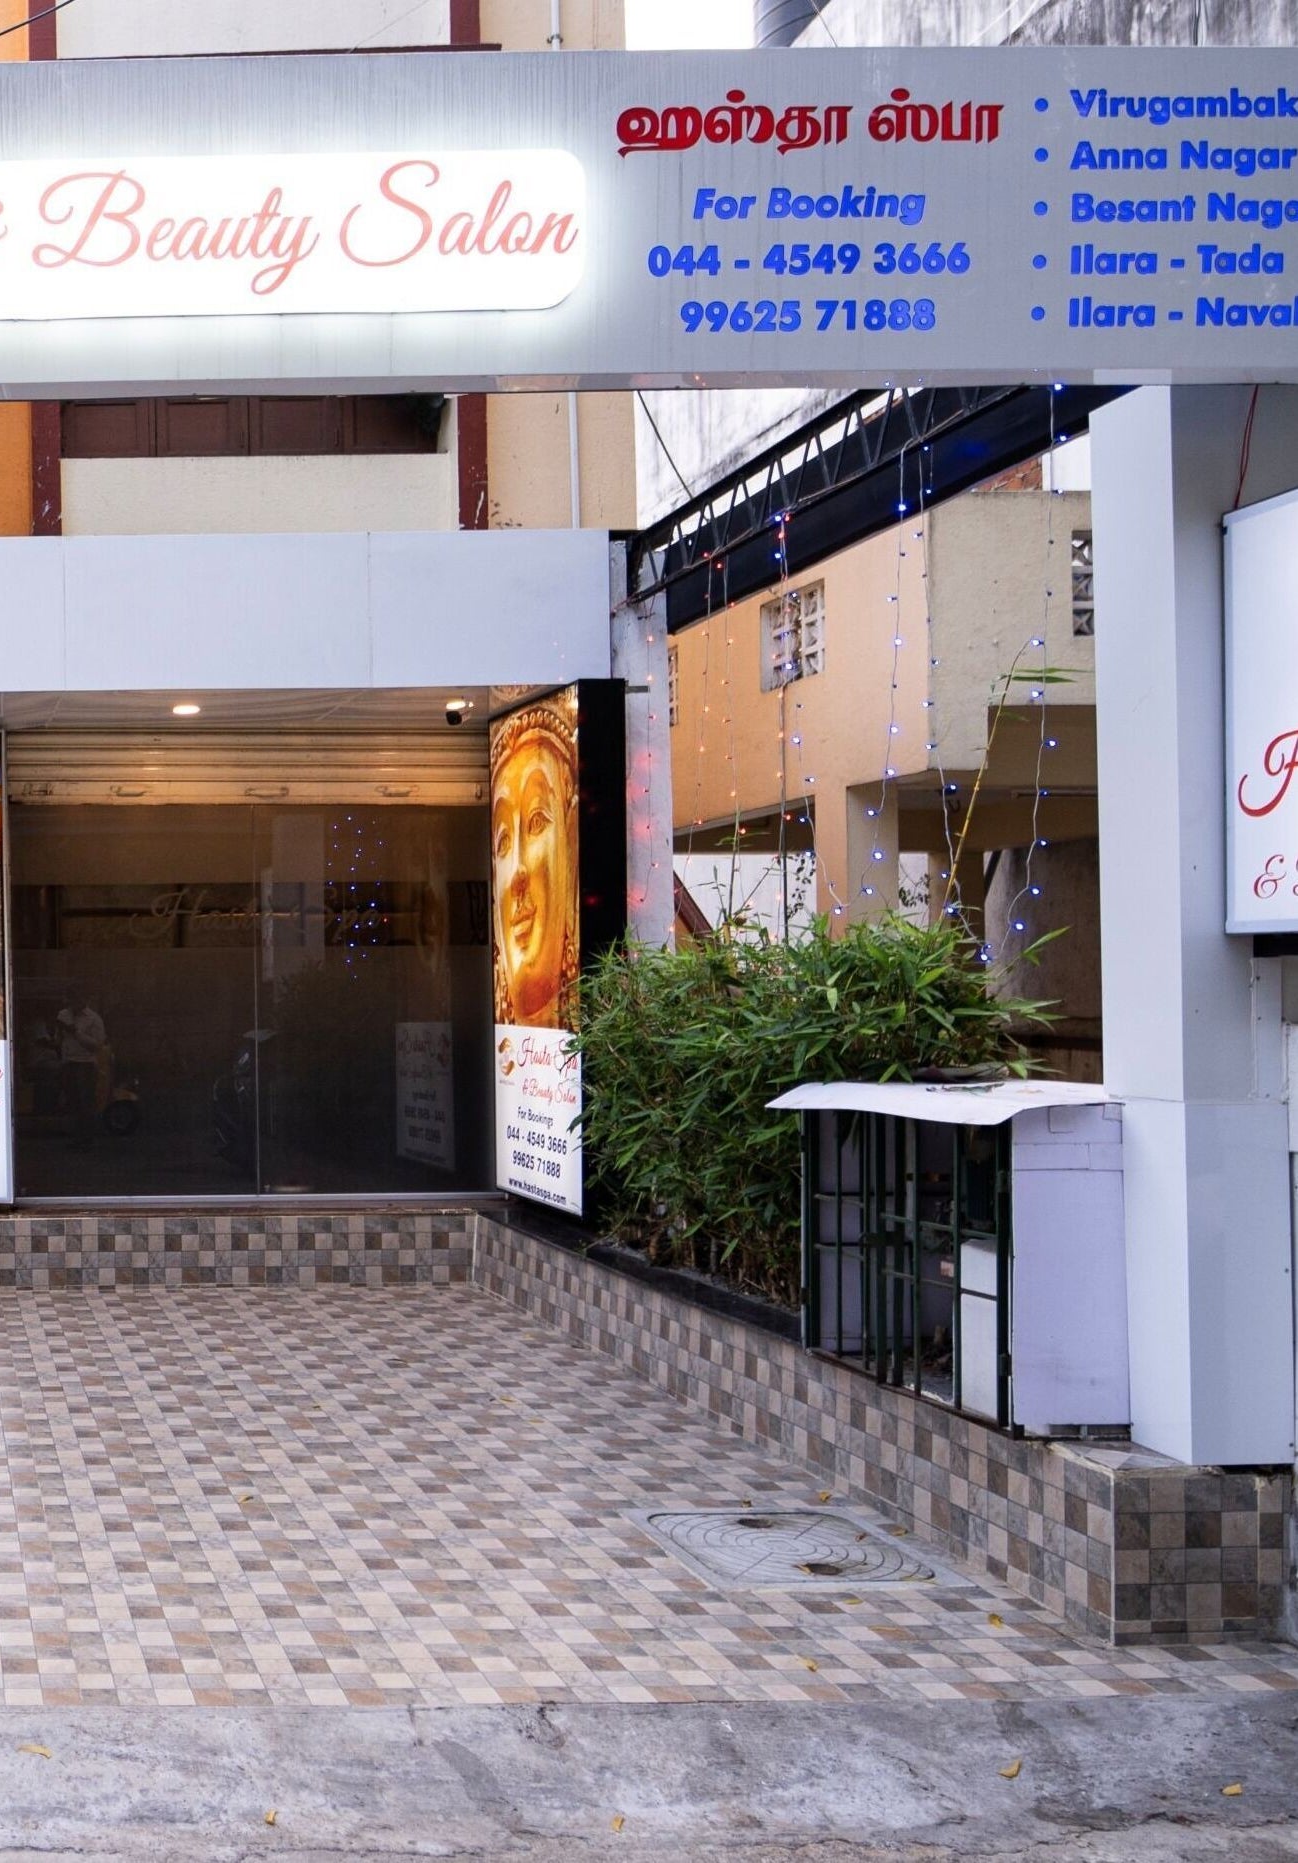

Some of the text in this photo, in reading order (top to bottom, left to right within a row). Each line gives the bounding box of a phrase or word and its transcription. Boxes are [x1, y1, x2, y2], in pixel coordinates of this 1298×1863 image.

[616, 87, 1004, 159] ஹஸ்தா ஸ்பா
[1069, 87, 1298, 126] Virugambak
[1069, 140, 1297, 177] Anna Nagar
[693, 185, 926, 225] For Booking
[1071, 192, 1196, 223] Besant
[31, 169, 320, 296] Beauty
[339, 159, 579, 267] Salon
[648, 244, 721, 277] 044
[763, 243, 861, 276] 4549
[873, 242, 971, 275] 3666
[1070, 244, 1158, 275] Ilara
[1196, 243, 1284, 274] Tada
[680, 298, 936, 333] 99625 71888
[1068, 296, 1156, 328] Ilara
[1254, 855, 1287, 899] &
[516, 1036, 553, 1068] Hasta
[517, 1106, 554, 1130] For Bookings
[507, 1125, 520, 1141] 044
[527, 1130, 546, 1150] 4549
[547, 1135, 567, 1155] 3666
[513, 1150, 561, 1179] 99625 71888
[508, 1177, 567, 1205] www.hastaspa.com
